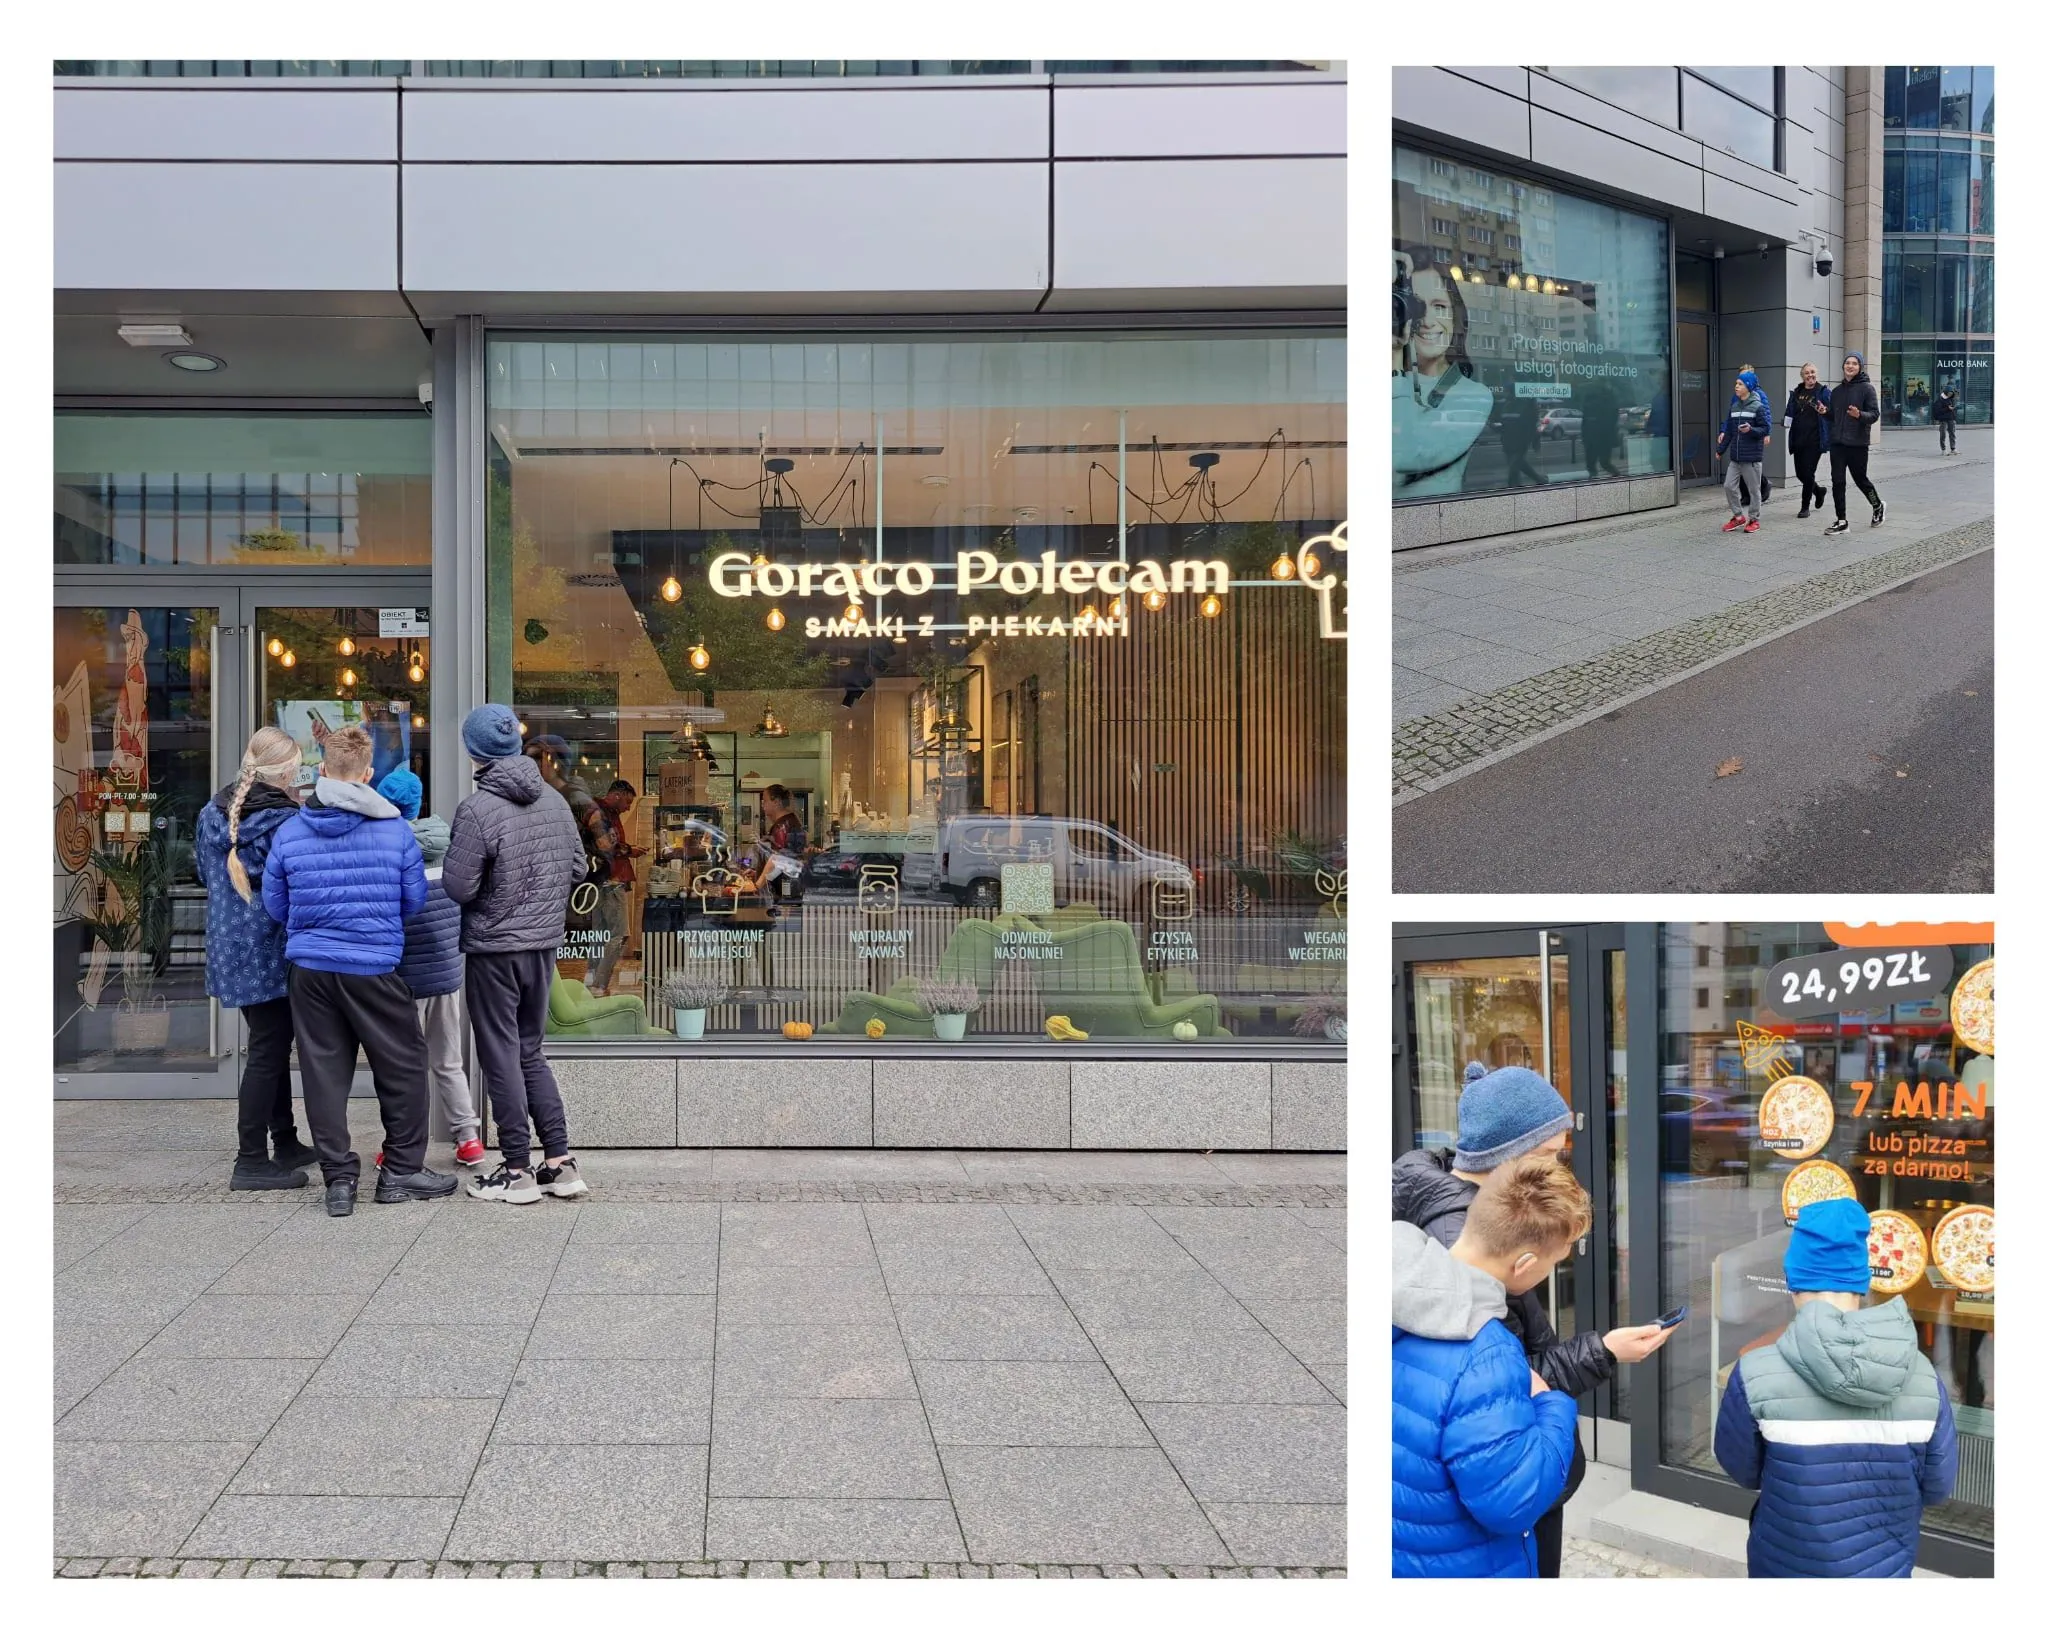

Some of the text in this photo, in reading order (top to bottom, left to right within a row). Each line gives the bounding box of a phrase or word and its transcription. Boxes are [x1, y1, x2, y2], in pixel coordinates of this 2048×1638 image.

[1514, 333, 1604, 356] Profesjonalne
[1514, 358, 1638, 379] usługi fotograficzne
[1937, 360, 1988, 368] ALIOR BANK
[708, 550, 1230, 605] Gorąco Polecam
[805, 615, 1129, 638] SMAKI Z PIEKARNI
[570, 930, 611, 944] ZIARNO
[677, 929, 765, 944] PRZYGOTOWANE
[850, 930, 914, 943] NATURALNY
[1001, 929, 1053, 945] ODWIEDŹ
[1152, 931, 1193, 945] CZYSTA
[1303, 929, 1347, 945] WEGAŃ
[556, 946, 605, 960] BRAZYLII
[689, 946, 752, 960] NA MIEJSCU
[858, 946, 905, 959] ZAKWAS
[994, 946, 1063, 960] NAS ONLINE!
[1147, 947, 1199, 961] ETYKIETA
[1288, 947, 1347, 961] WEGETARI
[1781, 950, 1931, 1004] 24,99ZŁ
[1850, 1080, 1987, 1120] 7 MIN
[1763, 1139, 1787, 1149] Szynka
[1869, 1132, 1966, 1156] lub pizza
[1863, 1157, 1970, 1180] za darmo!
